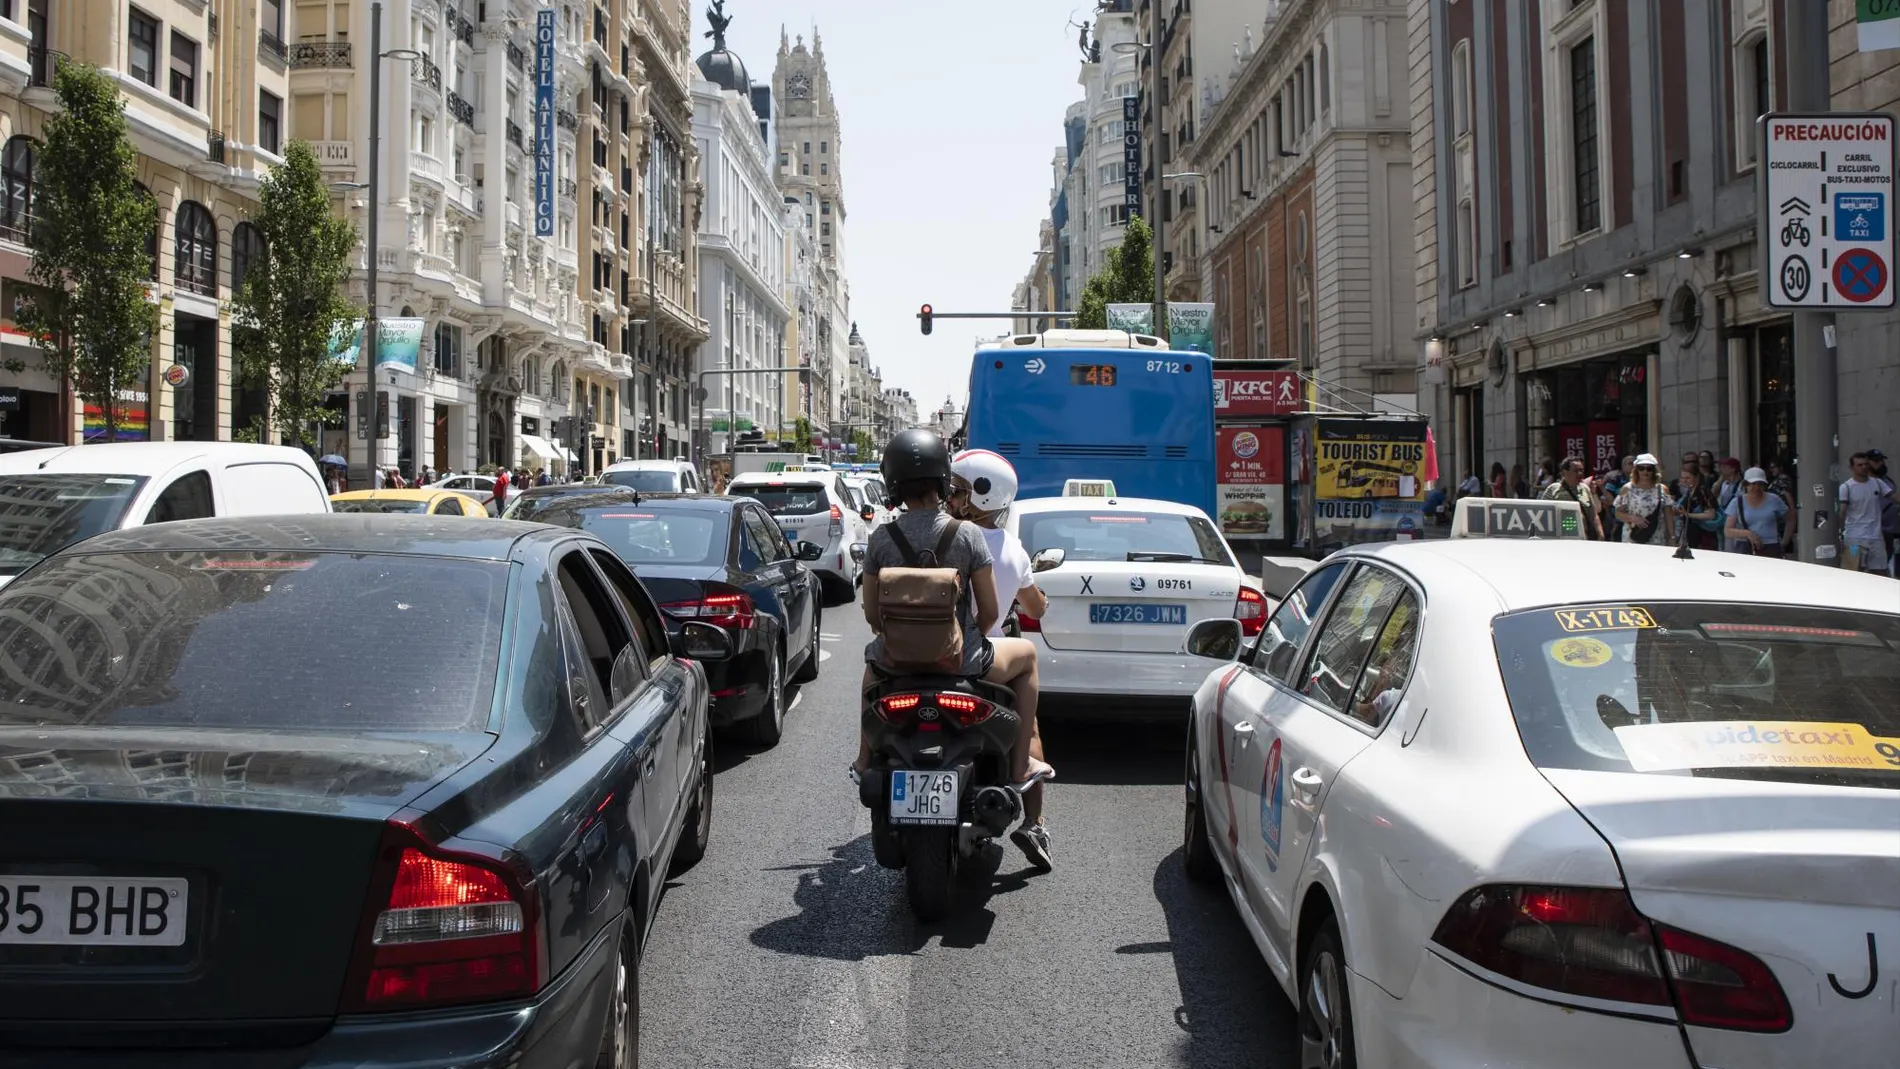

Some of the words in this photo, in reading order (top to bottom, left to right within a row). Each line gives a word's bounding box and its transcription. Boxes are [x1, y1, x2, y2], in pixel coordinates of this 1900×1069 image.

[538, 13, 551, 86] HOTEL
[1774, 121, 1886, 141] PRECAUCIÓN
[1125, 121, 1138, 187] HOTEL
[1844, 154, 1872, 162] CARRIL
[538, 96, 551, 231] ATLANTICO
[1827, 176, 1891, 184] BUS-TAXI-MOTOS
[1787, 266, 1804, 290] 30
[1107, 308, 1146, 318] Nuestro
[1170, 308, 1208, 317] Nuestro
[1171, 318, 1200, 329] Mayor
[1172, 326, 1207, 337] Orgullo
[1147, 361, 1180, 374] 8712
[1086, 366, 1113, 386] 46
[1231, 381, 1272, 395] KFC
[1566, 438, 1584, 450] RE
[1596, 434, 1616, 447] RE
[1322, 442, 1388, 460] TOURIST
[1391, 444, 1423, 460] BUS
[1597, 447, 1617, 459] BA
[1242, 461, 1246, 470] 1
[1593, 460, 1612, 472] JA
[1082, 485, 1104, 495] TAXI
[1318, 502, 1372, 518] TOLEDO
[1491, 508, 1554, 532] TAXI
[1080, 576, 1093, 594] X
[1157, 579, 1192, 590] 09761
[1100, 606, 1144, 622] 7326
[1151, 607, 1181, 623] JWM
[1560, 610, 1649, 629] X-1743
[1822, 754, 1873, 765] Madrid
[908, 775, 952, 794] 1746
[896, 788, 903, 796] E
[907, 795, 940, 814] JHG
[69, 886, 169, 935] BHB
[1826, 932, 1878, 999] J
